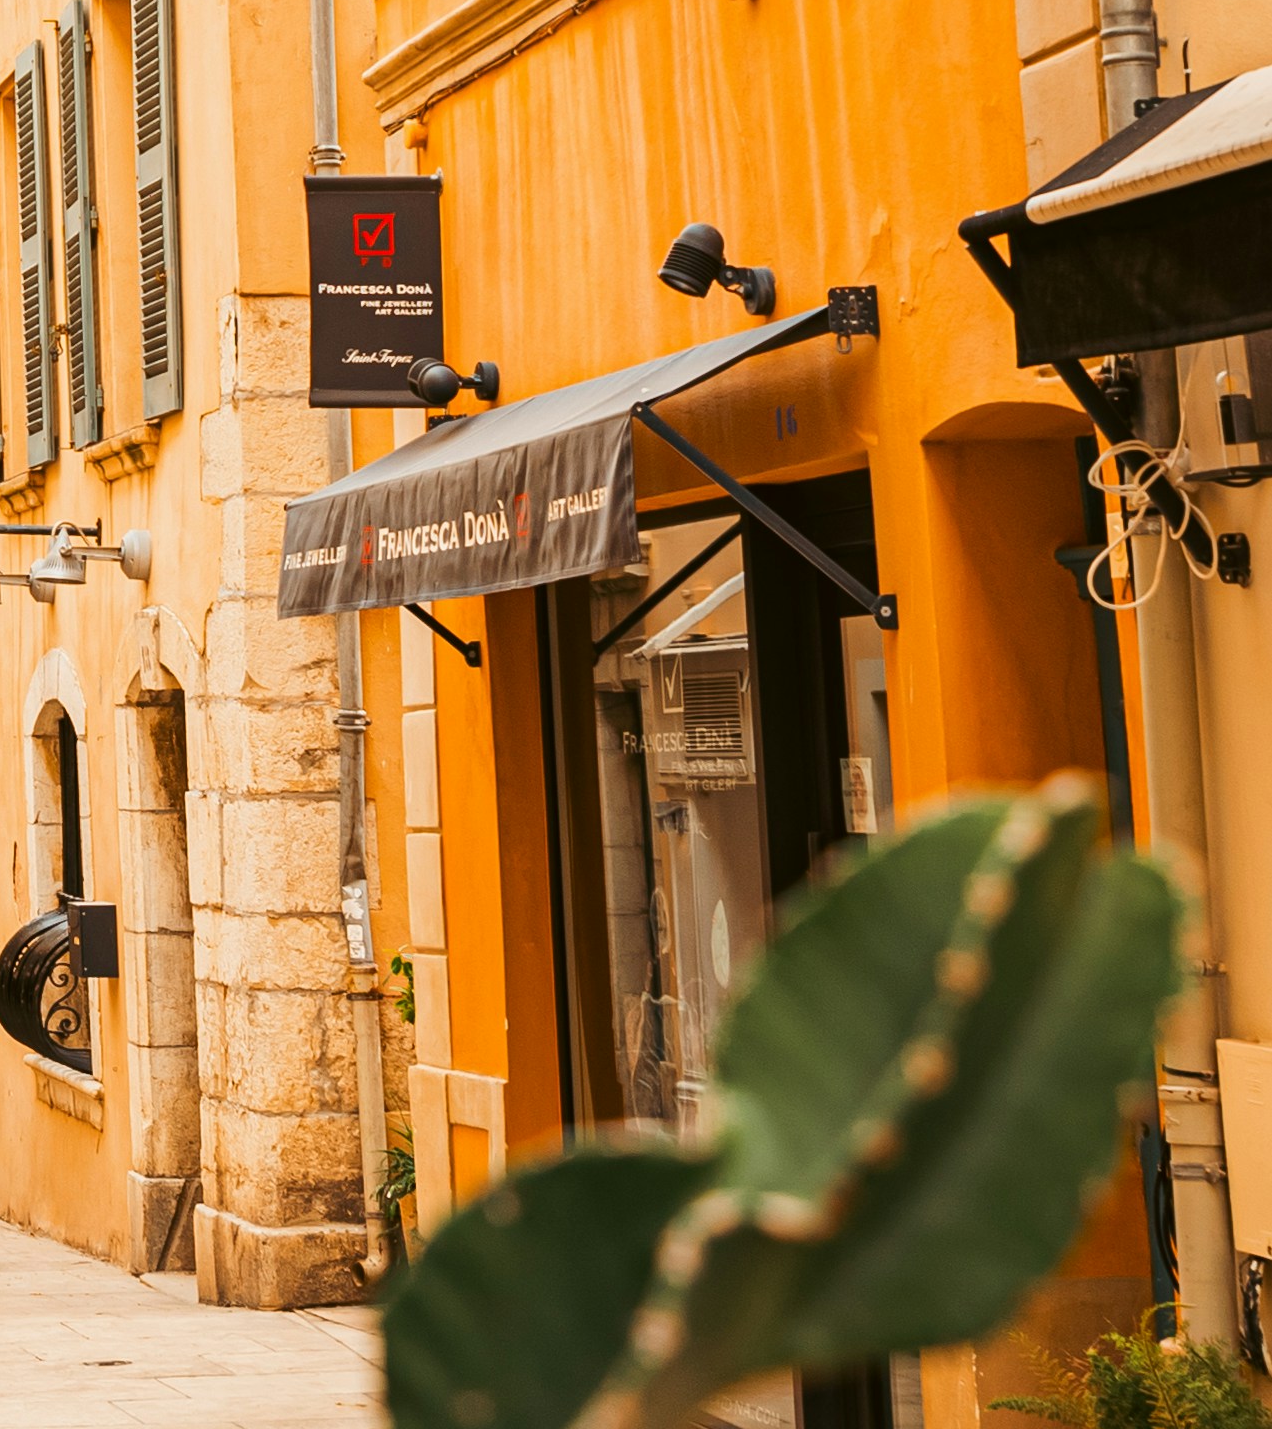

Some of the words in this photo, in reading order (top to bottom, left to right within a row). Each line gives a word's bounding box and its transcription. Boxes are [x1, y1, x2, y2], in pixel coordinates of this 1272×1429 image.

[318, 283, 393, 295] FRANCESCA
[396, 283, 433, 295] DONÀ
[360, 300, 381, 308] FINE
[383, 300, 433, 308] JEWELLERY
[375, 308, 392, 316] ART
[394, 308, 433, 316] GALLERY
[548, 497, 567, 522] ART
[378, 520, 460, 561] FRANCESCA
[464, 499, 510, 547] DONÀ
